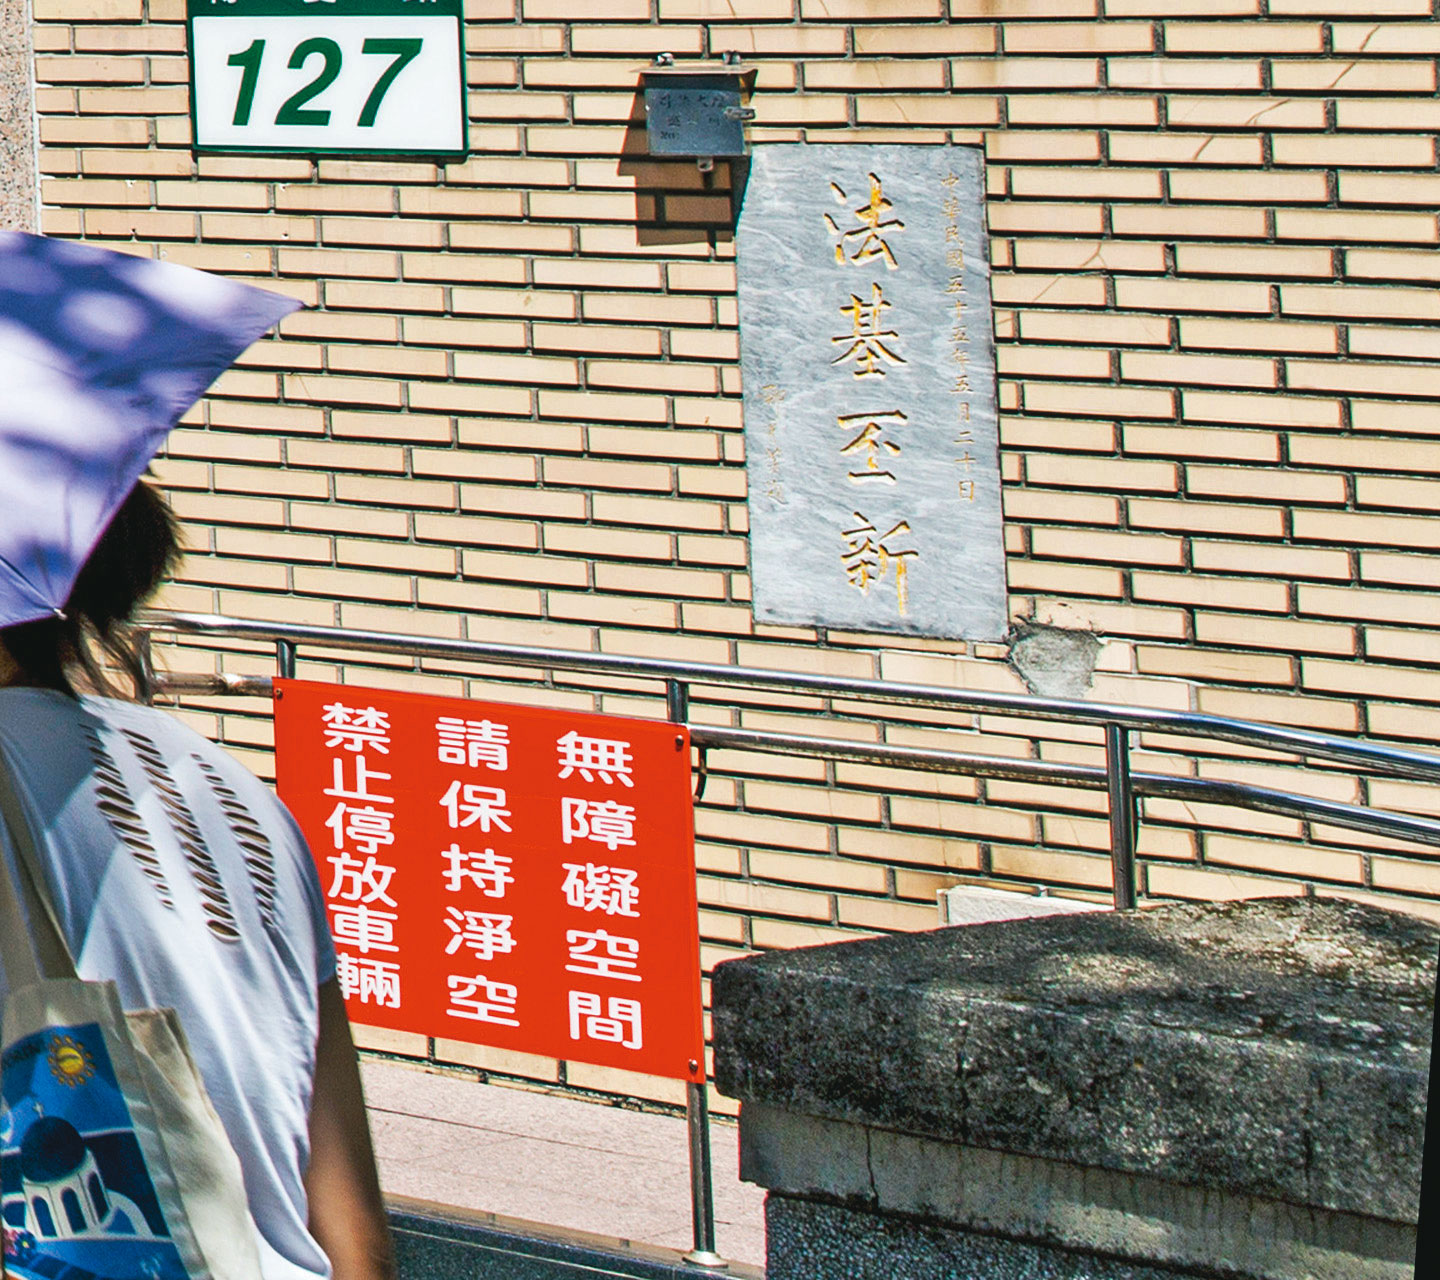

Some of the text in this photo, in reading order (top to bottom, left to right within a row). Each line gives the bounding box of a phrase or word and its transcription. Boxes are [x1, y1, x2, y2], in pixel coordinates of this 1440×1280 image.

[227, 37, 424, 128] 127
[940, 172, 977, 502] 中華民國五十五年五月二十日
[322, 702, 401, 1009] 禁止停放車輛
[435, 716, 521, 1028] 請保持淨空
[556, 730, 644, 1050] 無障礙空間
